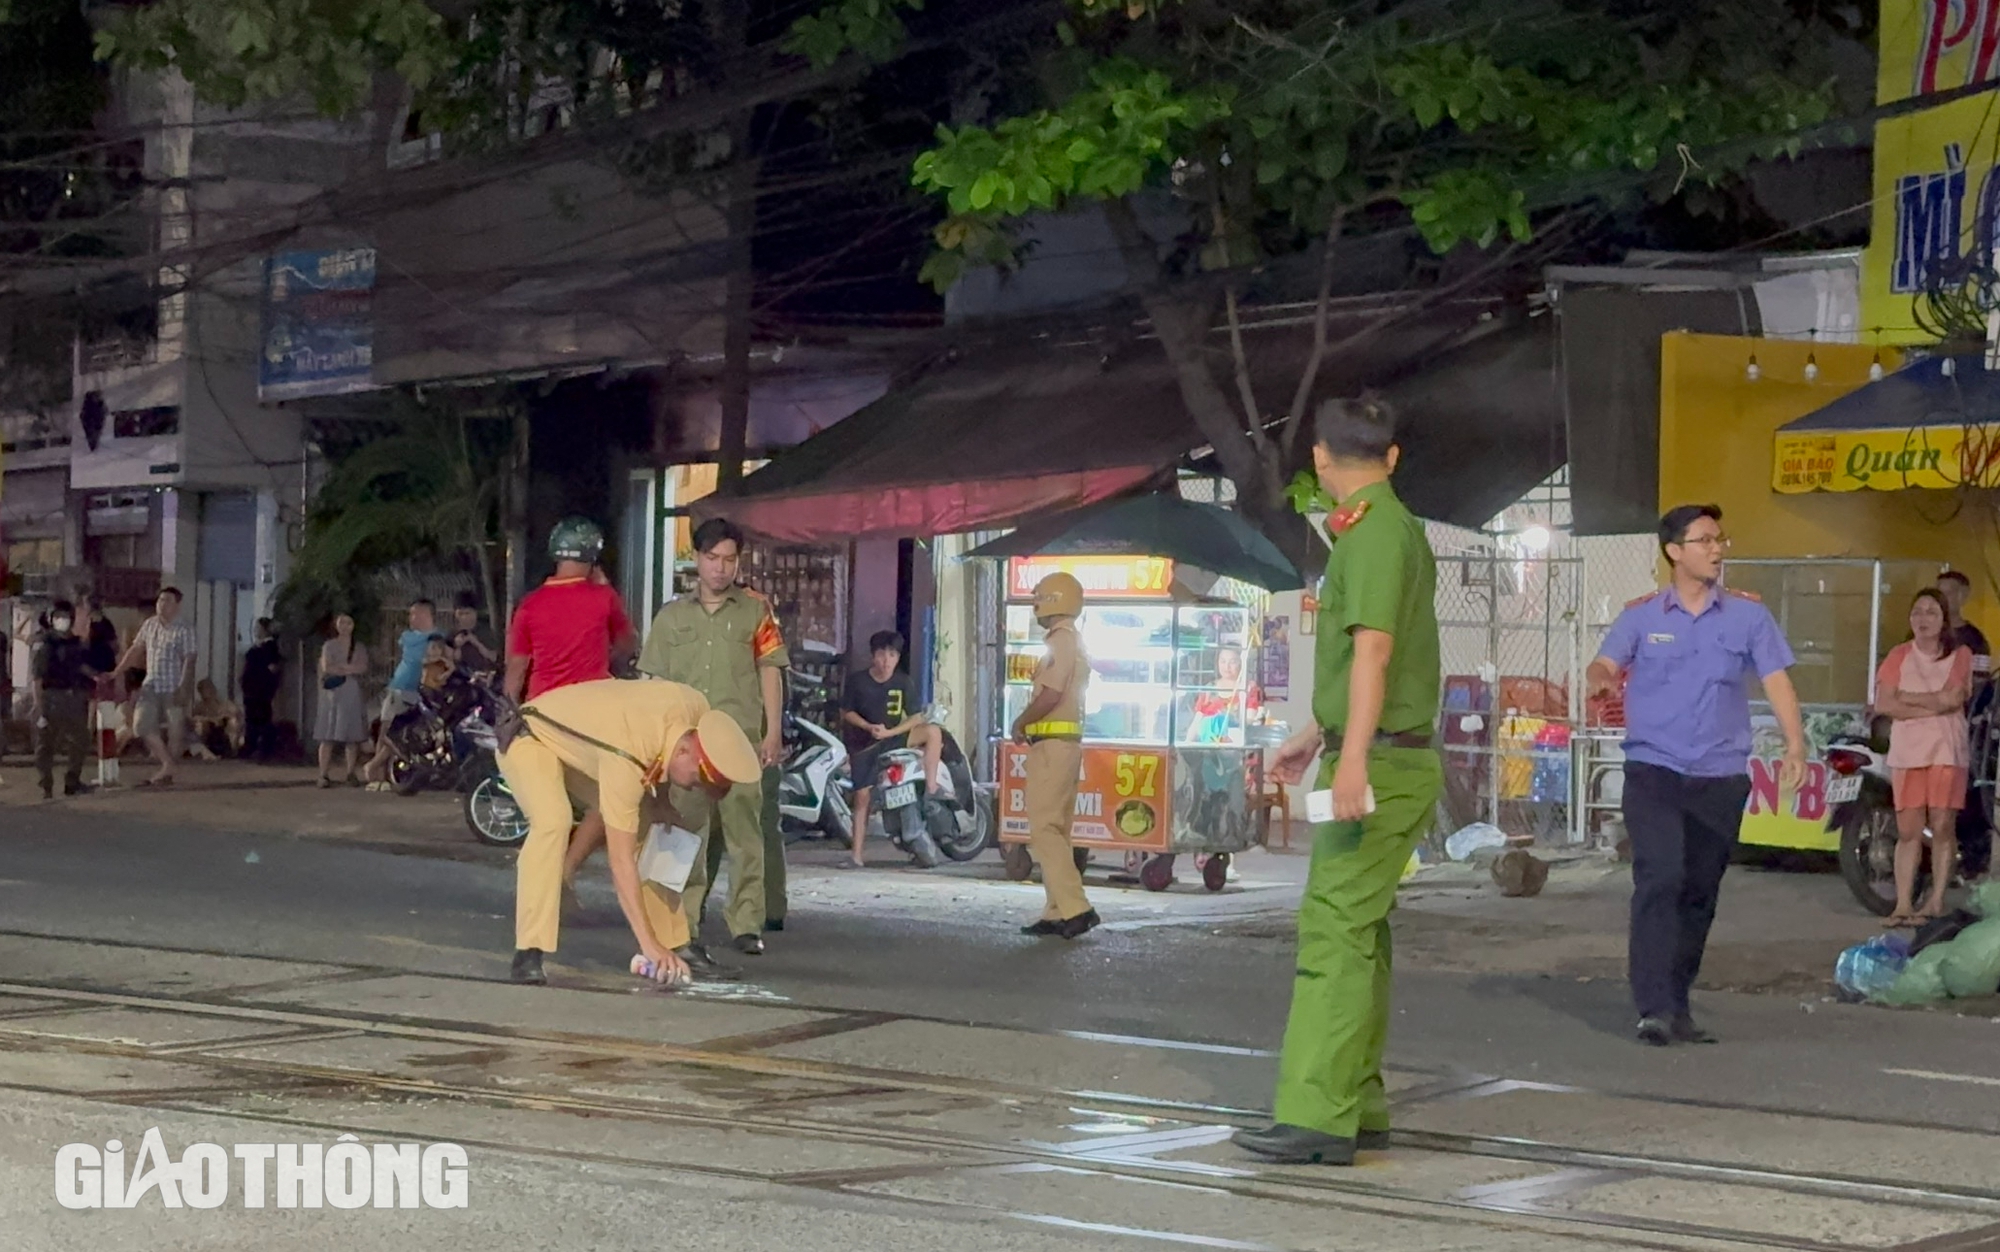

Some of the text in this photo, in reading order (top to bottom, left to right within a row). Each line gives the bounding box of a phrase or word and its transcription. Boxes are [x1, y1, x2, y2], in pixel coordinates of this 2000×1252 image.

[1843, 438, 1941, 482] Quán
[1134, 559, 1165, 590] 57
[1114, 754, 1159, 797] 57
